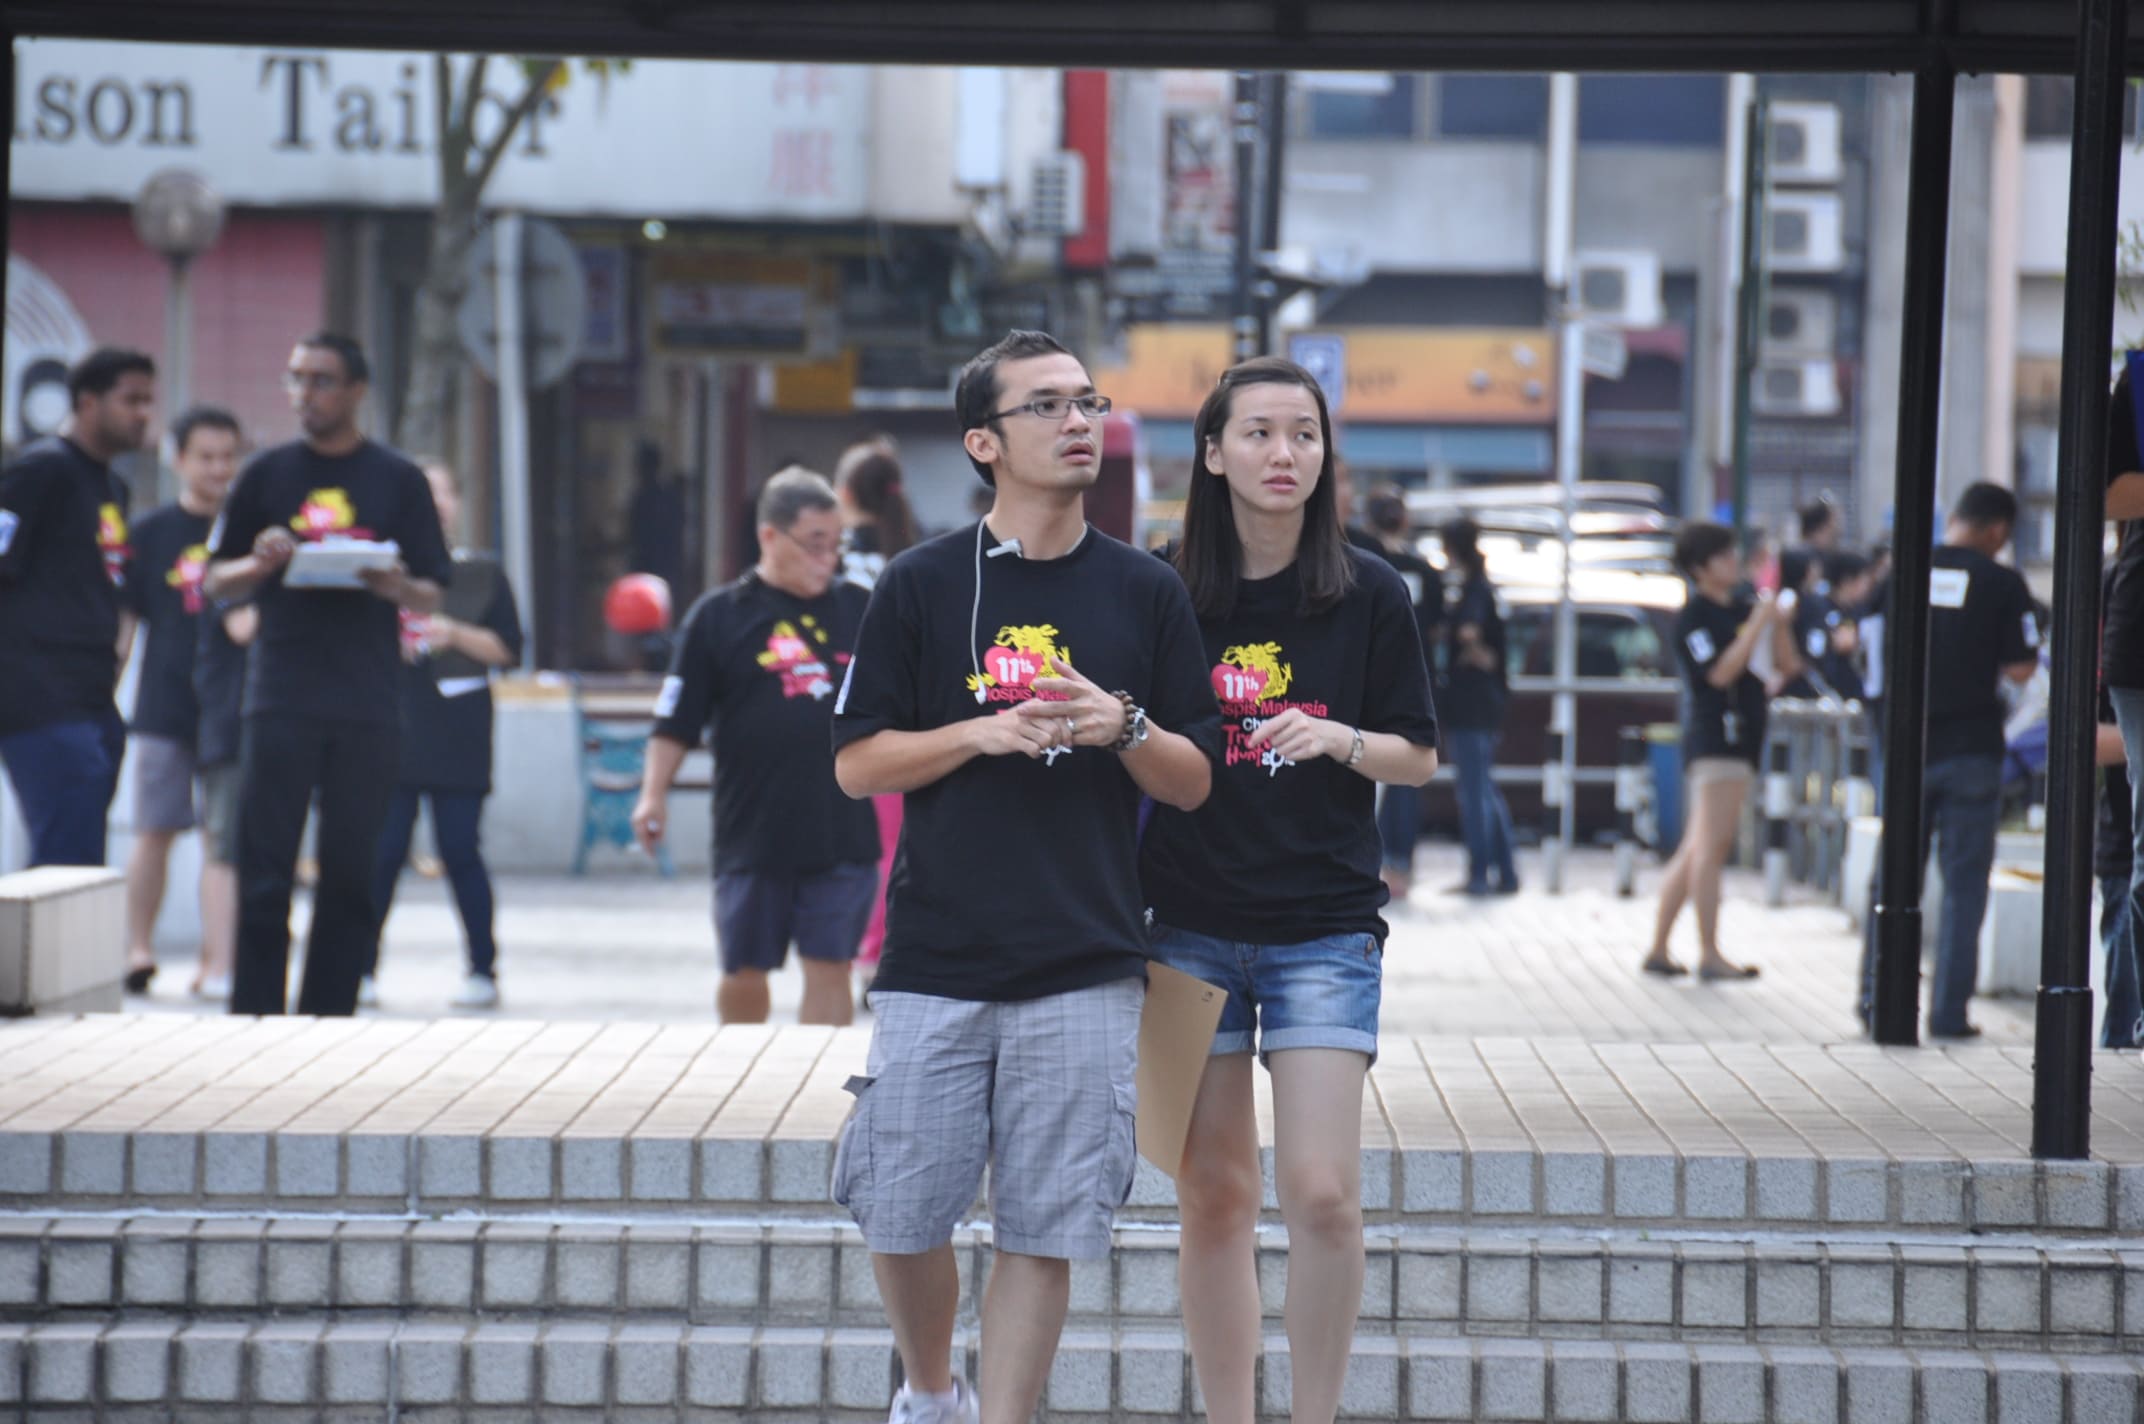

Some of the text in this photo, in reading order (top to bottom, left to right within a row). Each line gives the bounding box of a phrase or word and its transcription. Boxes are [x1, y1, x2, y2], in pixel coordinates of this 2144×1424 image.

[19, 56, 561, 156] son Taior
[995, 655, 1037, 684] 11th
[1222, 673, 1260, 699] 11th
